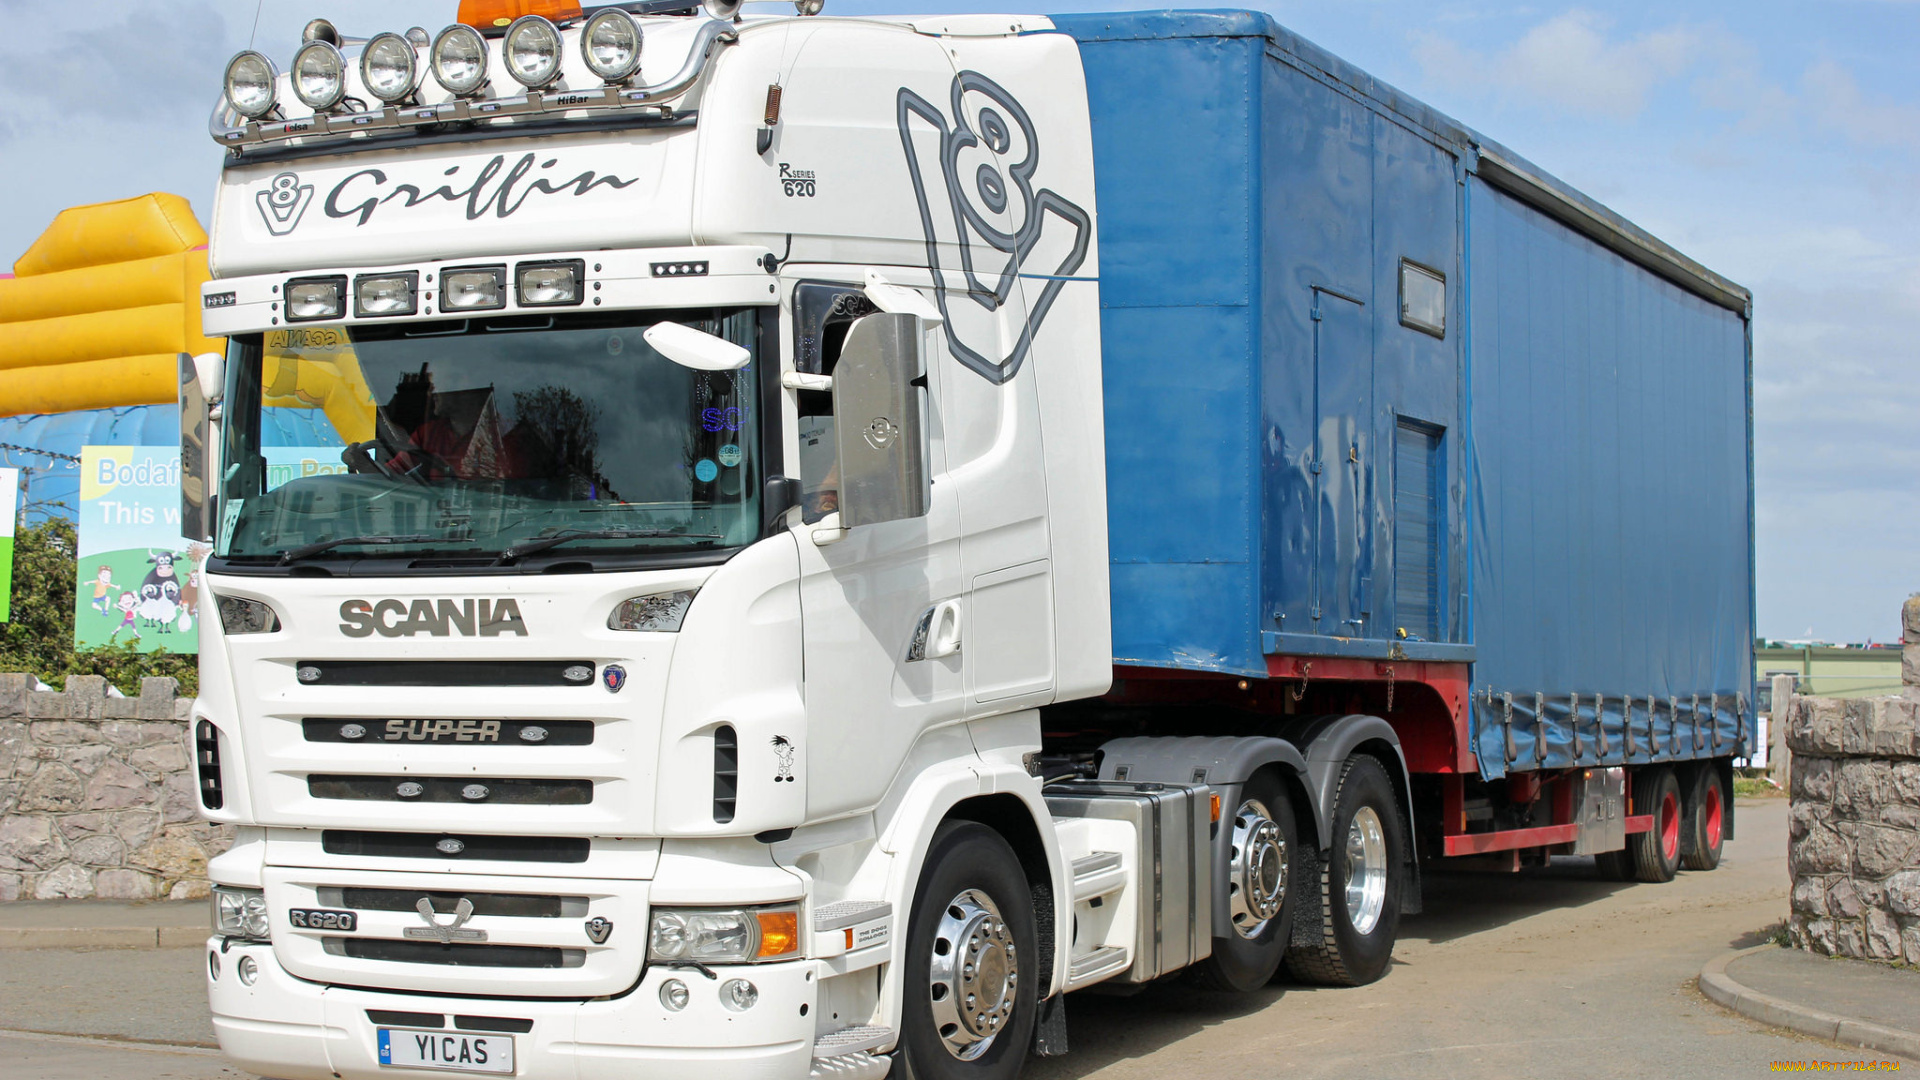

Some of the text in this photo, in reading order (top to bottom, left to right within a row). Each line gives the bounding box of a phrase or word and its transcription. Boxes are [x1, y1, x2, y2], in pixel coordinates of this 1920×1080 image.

[557, 95, 589, 106] HiBar
[283, 122, 309, 133] Kelsa
[322, 152, 640, 227] Griffin
[784, 181, 816, 198] 620
[98, 458, 181, 486] Bodaf
[98, 501, 155, 525] This
[339, 598, 528, 638] SCANIA
[384, 719, 501, 742] SUPER
[308, 911, 352, 930] 620
